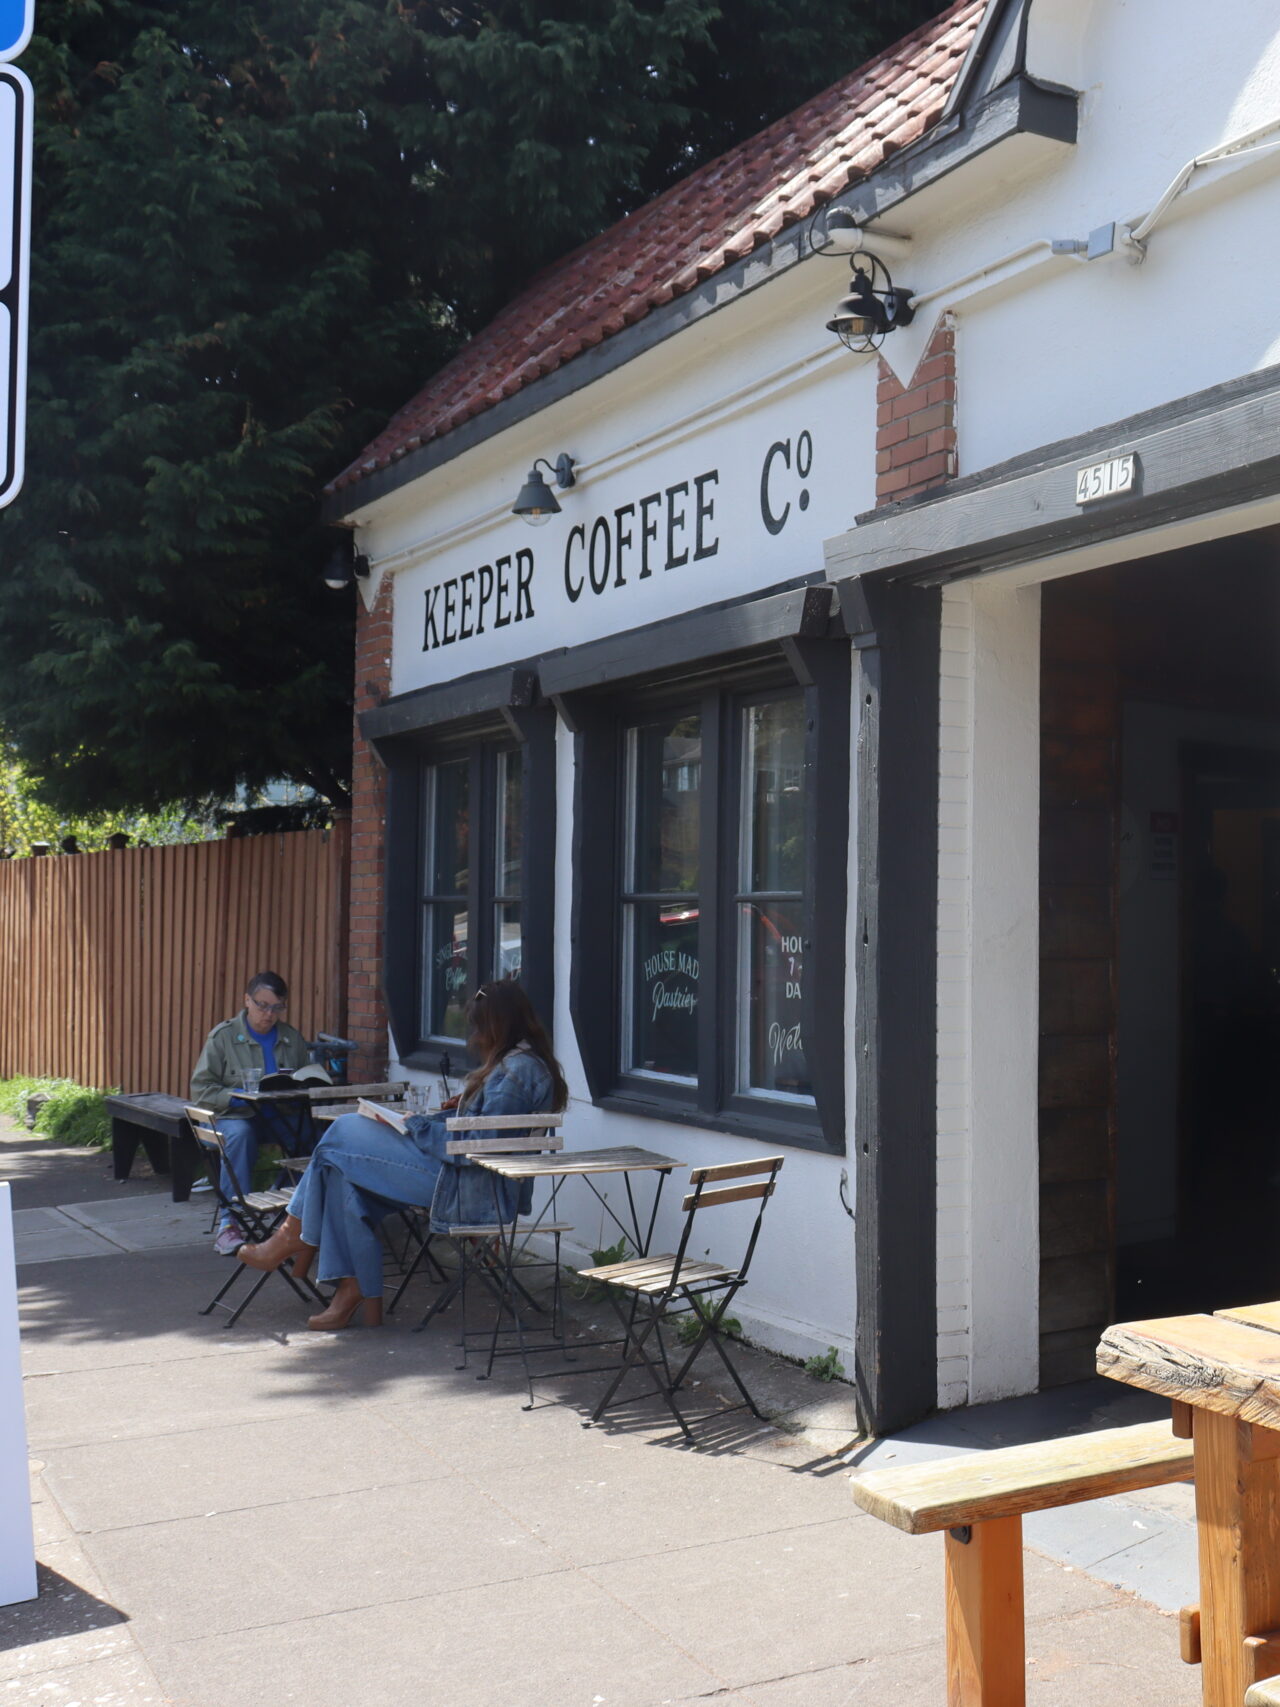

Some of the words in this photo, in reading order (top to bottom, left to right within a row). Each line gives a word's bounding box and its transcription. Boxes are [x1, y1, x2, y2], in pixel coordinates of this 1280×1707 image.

[1078, 458, 1132, 499] 4515
[422, 547, 535, 652] KEEPER
[564, 468, 719, 603] COFFEE
[644, 950, 675, 981] HOUSE
[678, 951, 699, 980] MAD
[786, 981, 802, 999] DA
